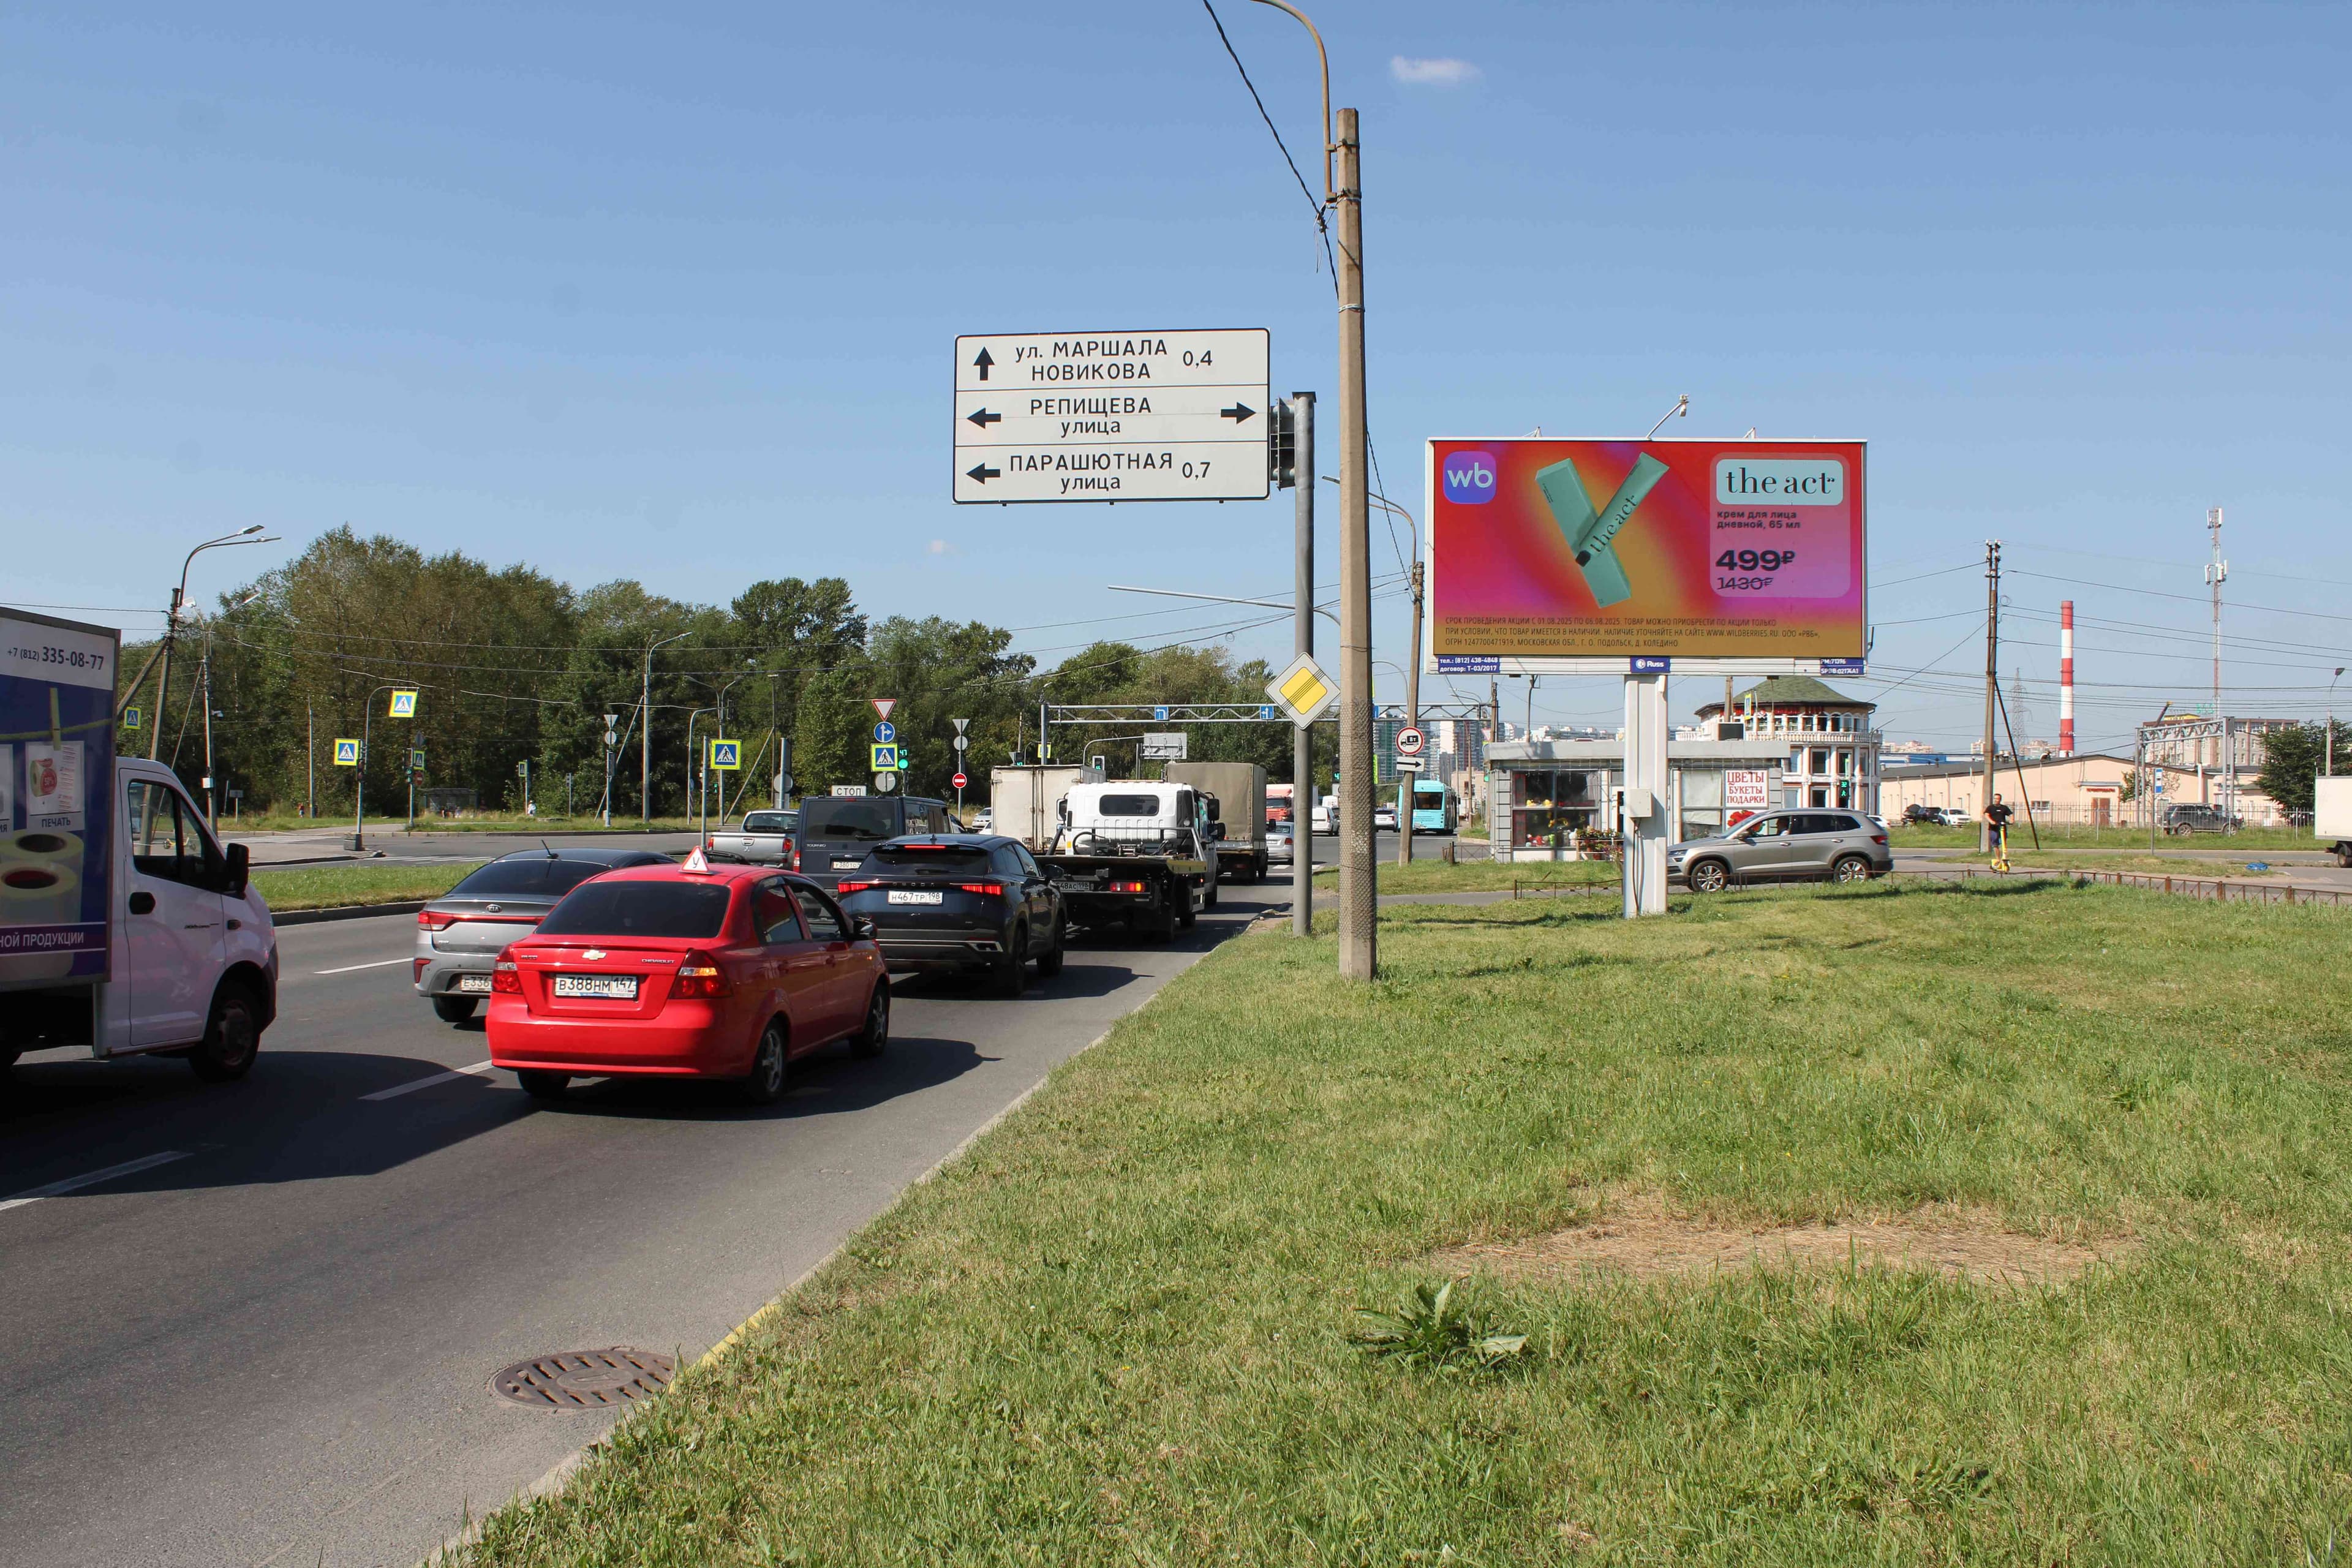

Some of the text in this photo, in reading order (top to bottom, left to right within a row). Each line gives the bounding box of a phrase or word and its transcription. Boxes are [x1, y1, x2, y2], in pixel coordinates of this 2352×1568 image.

[1015, 339, 1168, 363] ул. МАРШАЛА
[1182, 350, 1213, 368] 0,4
[1031, 363, 1151, 381] НОВИКОВА
[1030, 397, 1152, 418] РЕПИЩЕВА
[1060, 420, 1121, 438] улица
[1010, 453, 1173, 472] ПАРАШЮТНАЯ
[1182, 462, 1211, 481] 0,7
[1447, 462, 1493, 488] wb
[1060, 477, 1121, 494] улица
[1725, 467, 1777, 494] the
[1770, 511, 1797, 519] лица
[1717, 520, 1766, 529] дневной,
[1636, 628, 1673, 636] УТОЧНЯЙТЕ
[1685, 628, 1705, 636] САЙТЕ
[1597, 639, 1634, 647] ПОДОЛЬСК,
[7, 646, 104, 671] +7 (812) 335-08-77
[1727, 772, 1765, 785] ЦВЕТЫ
[837, 788, 862, 796] СТОП
[1729, 786, 1763, 794] БУКЕТЫ
[42, 817, 71, 828] ПЕЧАТЬ
[23, 932, 84, 948] ПРОДУКЦИИ
[559, 977, 633, 992] В388НМ 147
